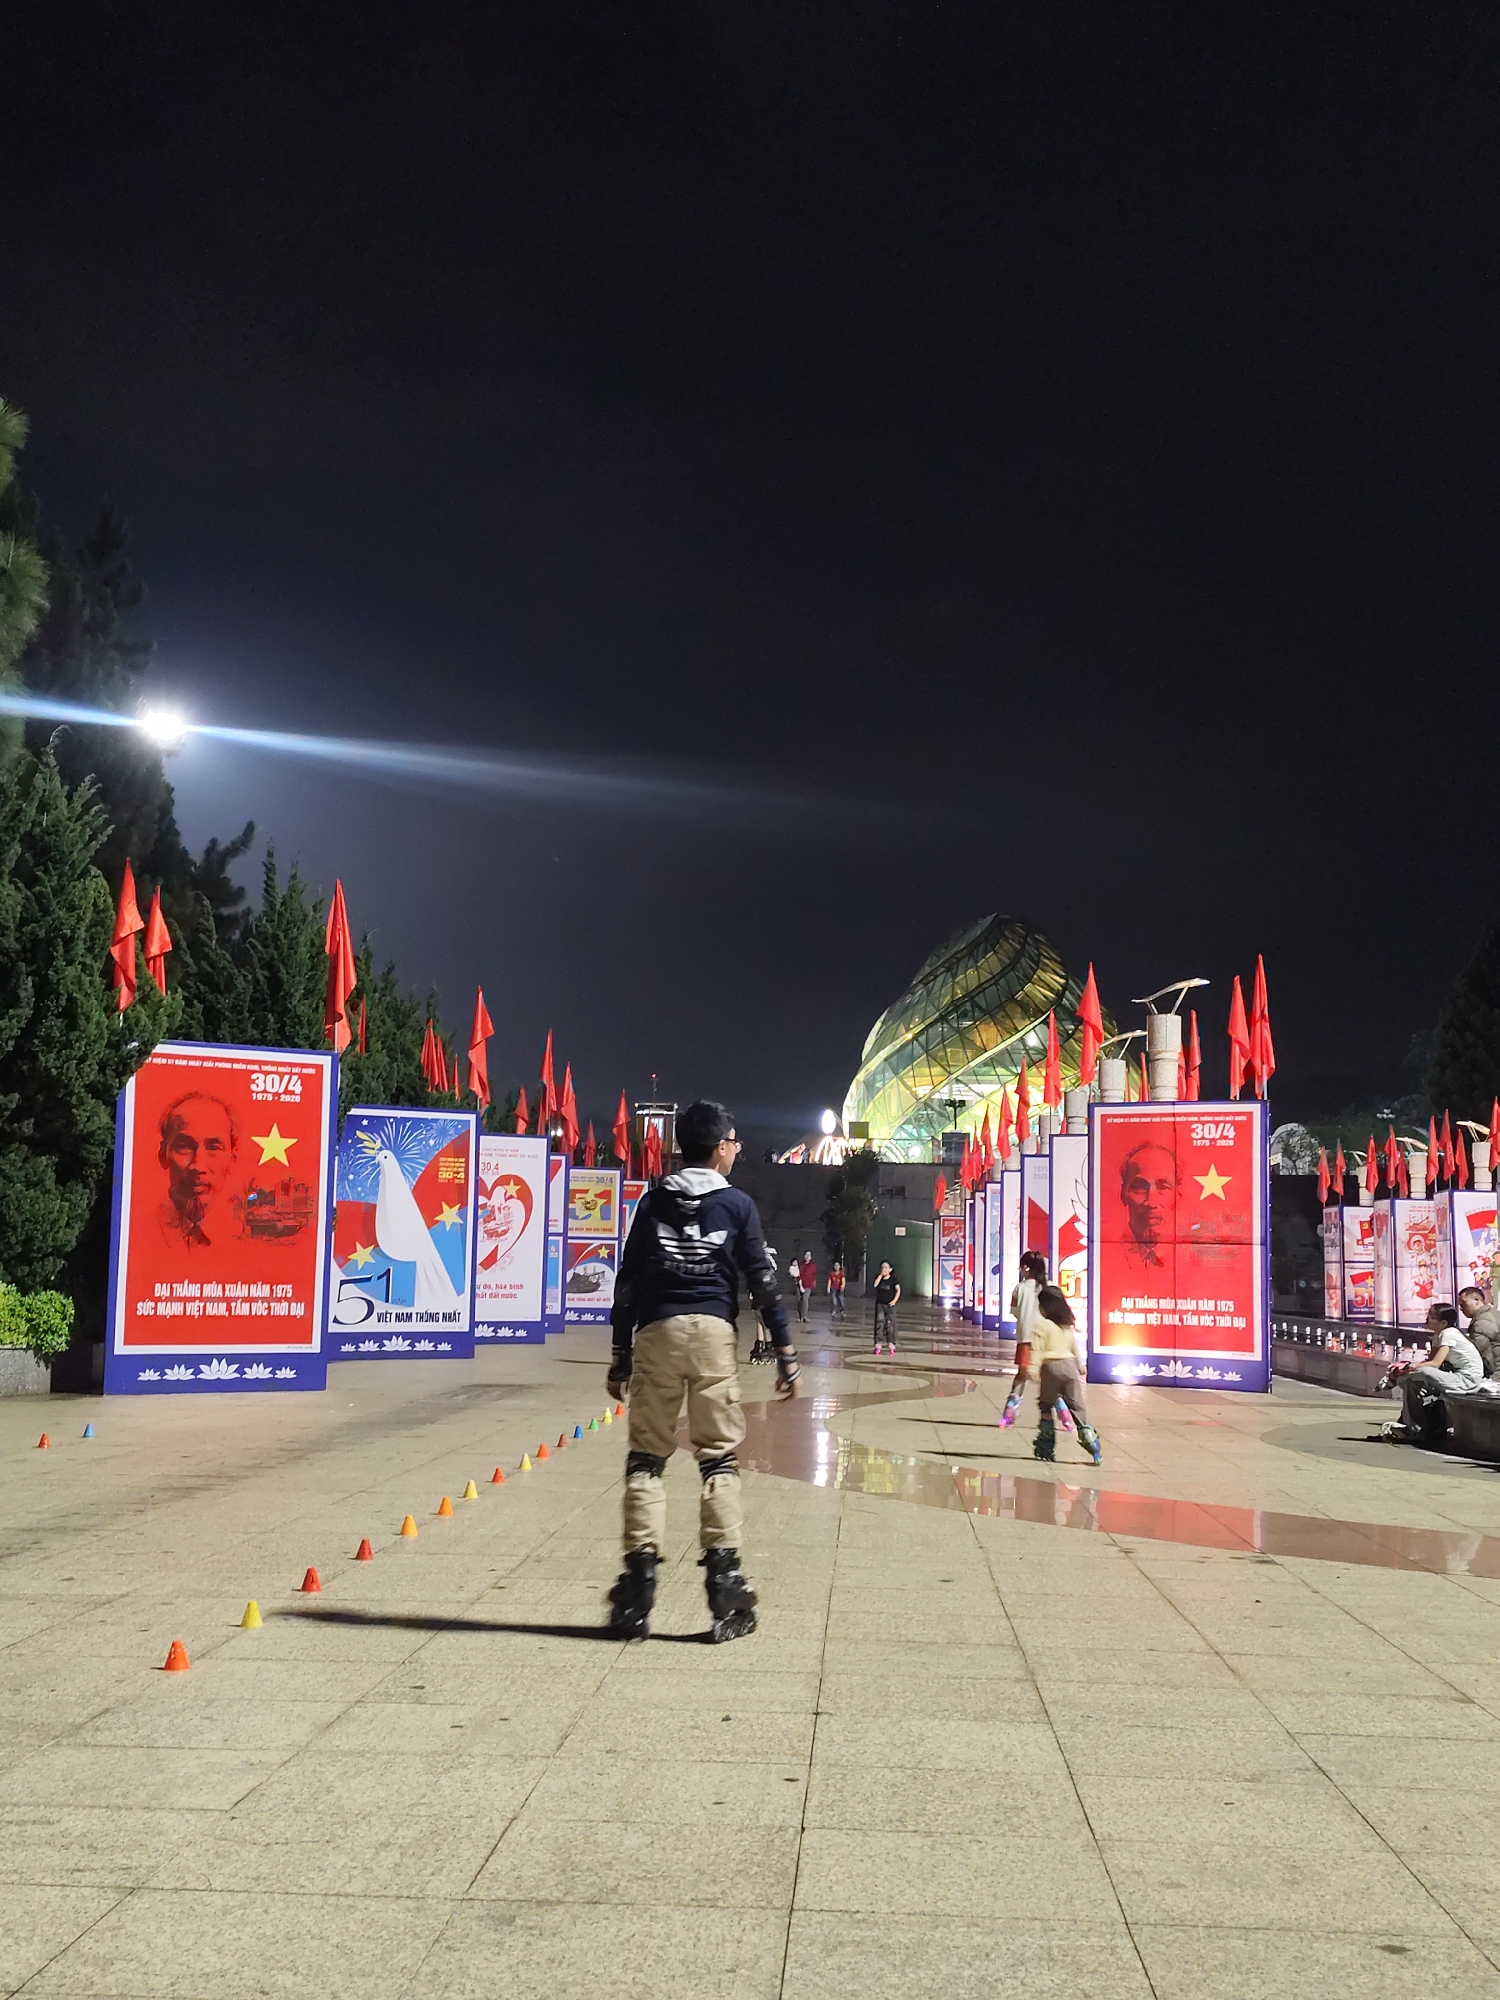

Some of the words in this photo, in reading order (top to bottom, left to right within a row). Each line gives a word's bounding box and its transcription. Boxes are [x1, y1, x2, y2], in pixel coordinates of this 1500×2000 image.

[250, 1073, 302, 1094] 30/4
[252, 1092, 272, 1101] 1975
[1191, 1123, 1235, 1139] 30/4
[154, 1283, 170, 1300] ĐẠI
[172, 1278, 200, 1297] THẮNG
[224, 1281, 248, 1297] XUÂN
[250, 1282, 270, 1297] NĂM
[272, 1284, 292, 1298] 1975
[1060, 1270, 1087, 1298] 51
[332, 1266, 392, 1325] 51
[1135, 1294, 1158, 1309] THẮNG
[1177, 1296, 1197, 1310] XUÂN
[1198, 1298, 1215, 1311] NĂM
[1216, 1300, 1234, 1312] 1975
[1354, 1288, 1374, 1308] 51
[136, 1298, 154, 1316] SỨC
[157, 1302, 183, 1318] MẠNH
[186, 1300, 204, 1318] VIỆT
[206, 1302, 228, 1318] NAM,
[251, 1300, 268, 1316] VÓC
[270, 1300, 288, 1316] THỜI
[290, 1302, 304, 1319] ĐẠI
[377, 1310, 392, 1325] VIỆT
[395, 1312, 412, 1323] NAM
[415, 1308, 439, 1323] THỐNG
[442, 1309, 461, 1322] NHẤT
[1146, 1312, 1161, 1327] VIỆT
[1200, 1313, 1214, 1326] VÓC
[1233, 1317, 1246, 1330] ĐẠI
